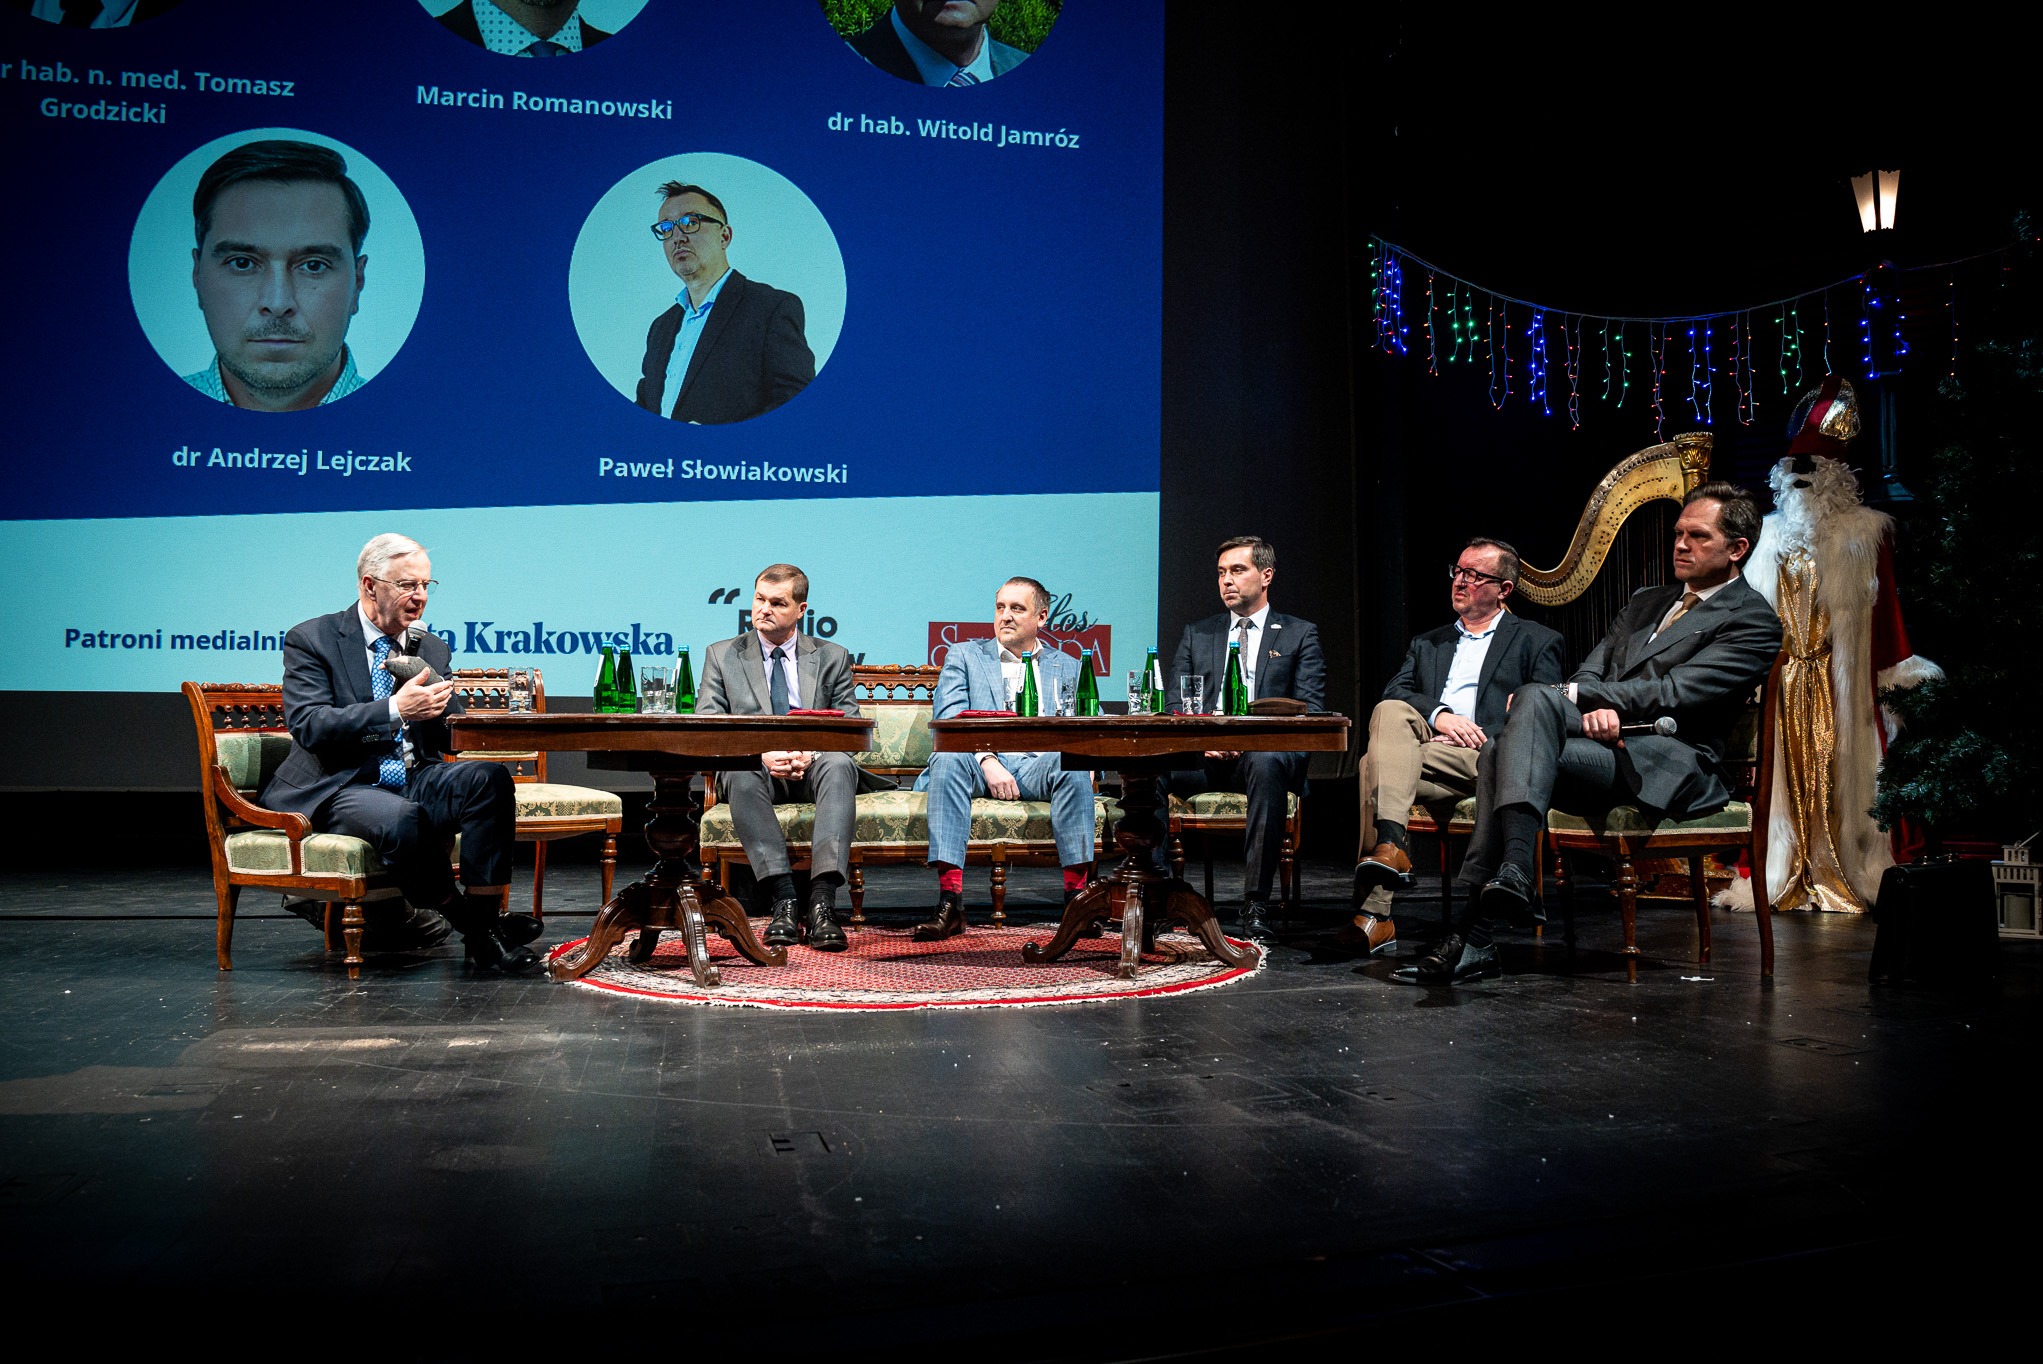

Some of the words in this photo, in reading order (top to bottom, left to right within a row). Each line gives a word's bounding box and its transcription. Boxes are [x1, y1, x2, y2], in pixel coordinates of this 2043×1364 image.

[1, 62, 13, 79] r
[21, 59, 80, 83] hab.
[88, 69, 113, 86] n.
[121, 69, 187, 90] med.
[194, 71, 295, 97] Tomasz
[40, 97, 166, 124] Grodzicki
[417, 85, 504, 109] Marcin
[512, 91, 673, 120] Romanowski
[827, 112, 854, 132] dr
[860, 114, 911, 136] hab.
[917, 119, 993, 142] Witold
[997, 125, 1080, 149] Jamróz
[172, 445, 202, 467] dr
[206, 447, 308, 476] Andrzej
[317, 450, 412, 476] Lejczak
[599, 457, 675, 478] Paweł
[681, 459, 848, 484] Słowiakowski
[463, 621, 675, 656] Krakowska
[738, 609, 838, 638] Rio
[65, 628, 162, 650] Patroni
[170, 629, 285, 651] medialni
